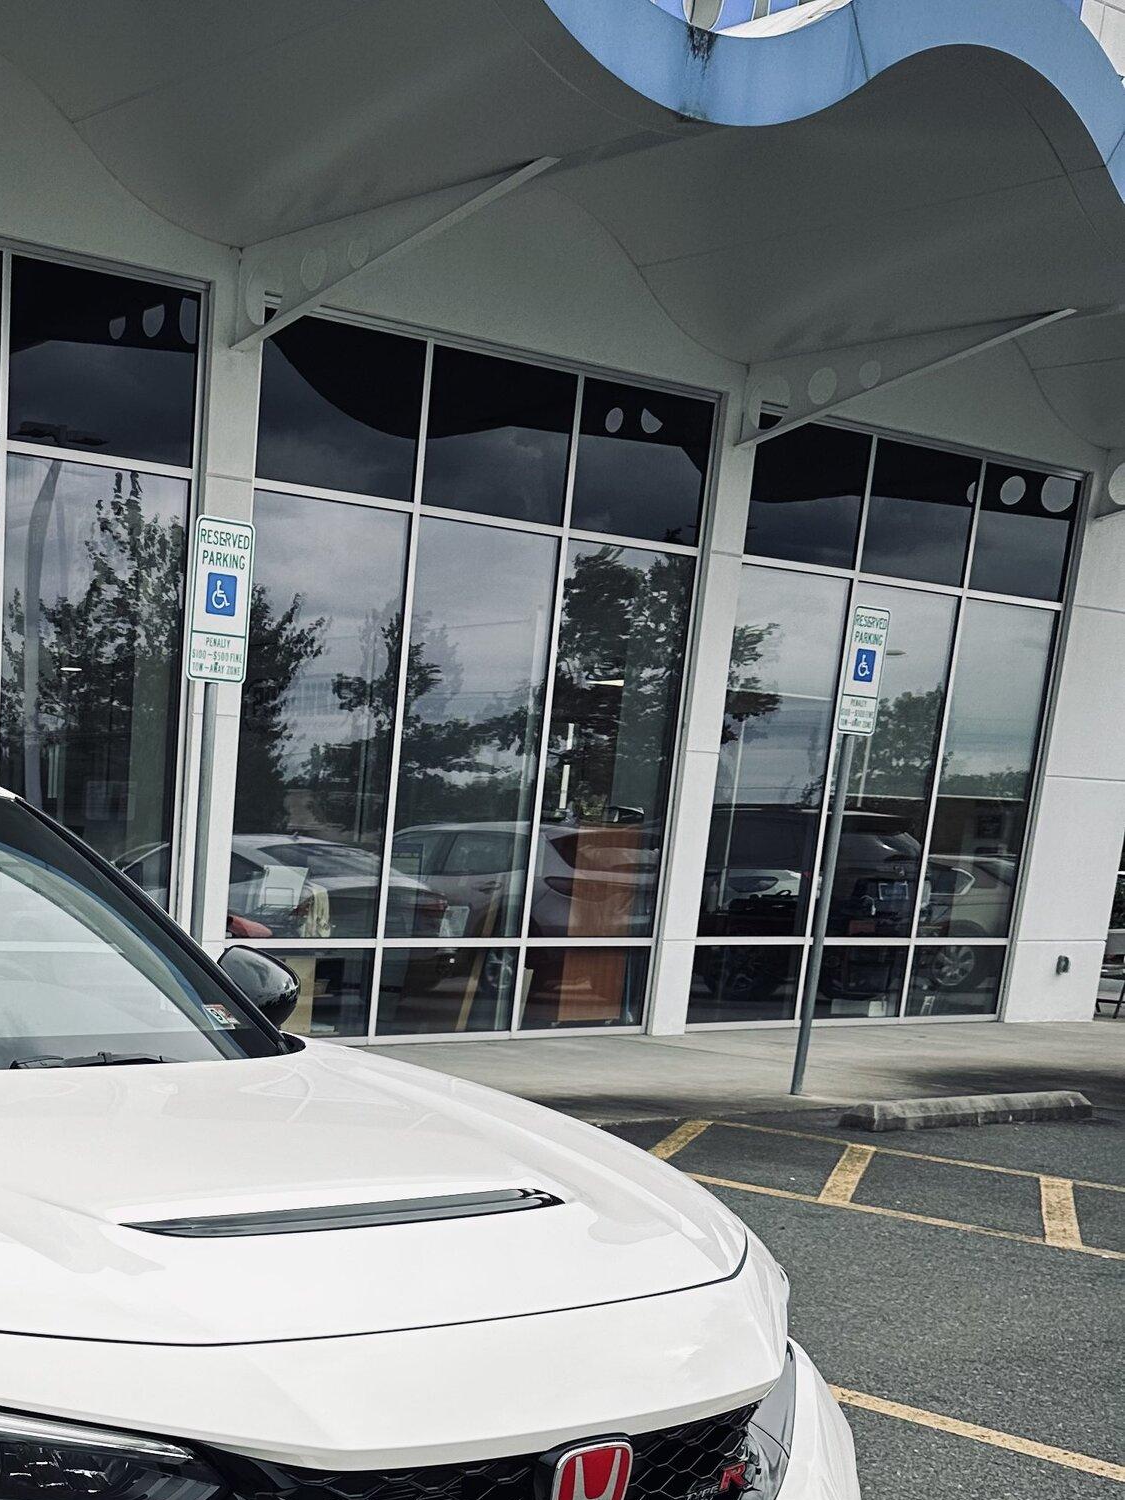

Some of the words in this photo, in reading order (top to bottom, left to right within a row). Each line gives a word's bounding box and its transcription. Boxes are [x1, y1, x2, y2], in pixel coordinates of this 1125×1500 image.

[200, 528, 250, 550] RESERVED
[202, 550, 246, 570] PARKING
[718, 1461, 748, 1493] R
